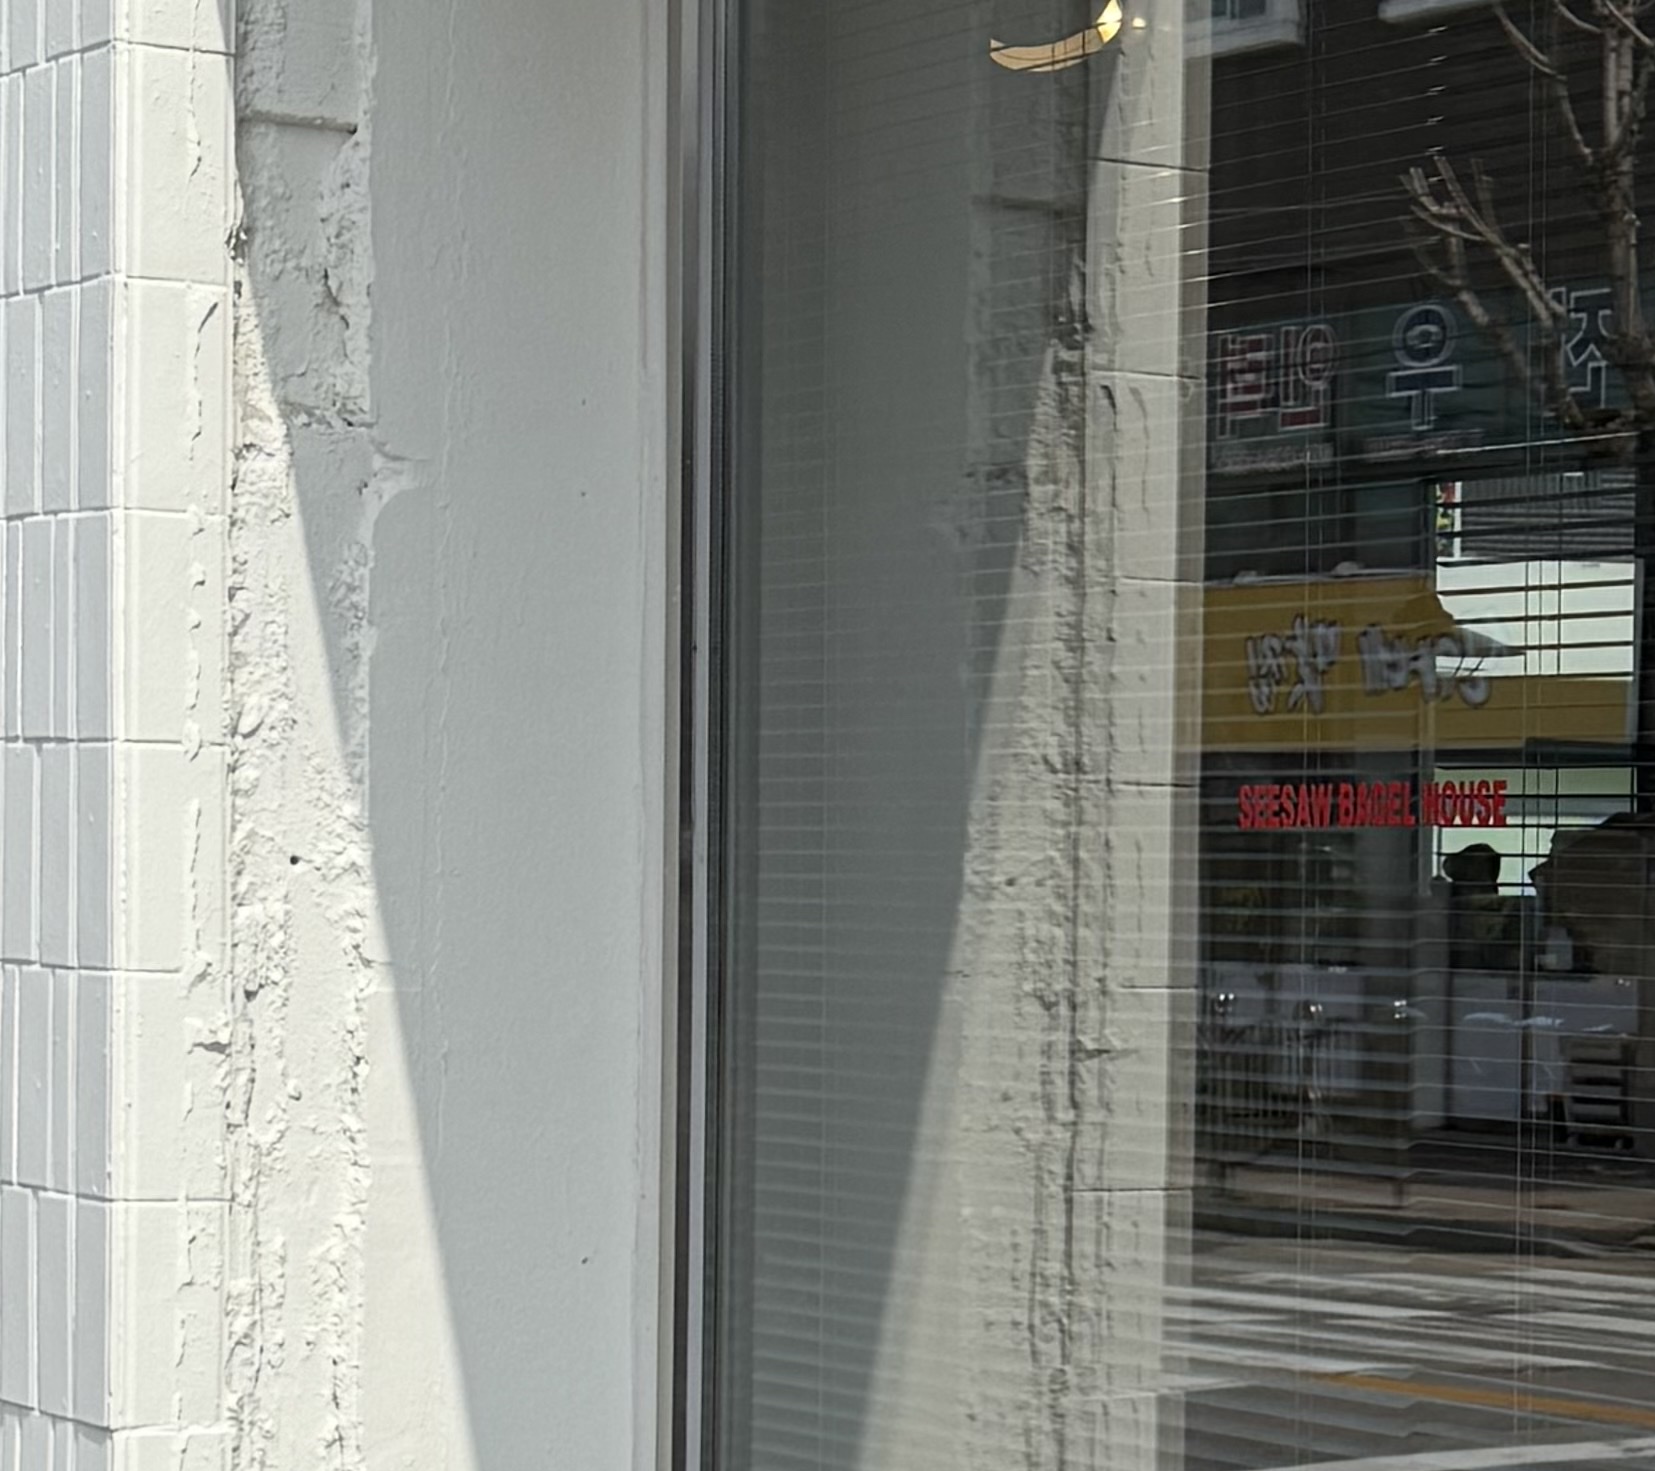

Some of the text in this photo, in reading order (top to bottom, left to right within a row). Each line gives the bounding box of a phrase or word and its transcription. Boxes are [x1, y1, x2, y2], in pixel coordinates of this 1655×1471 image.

[1237, 779, 1509, 830] SEESAW BAGEL HOUSE
